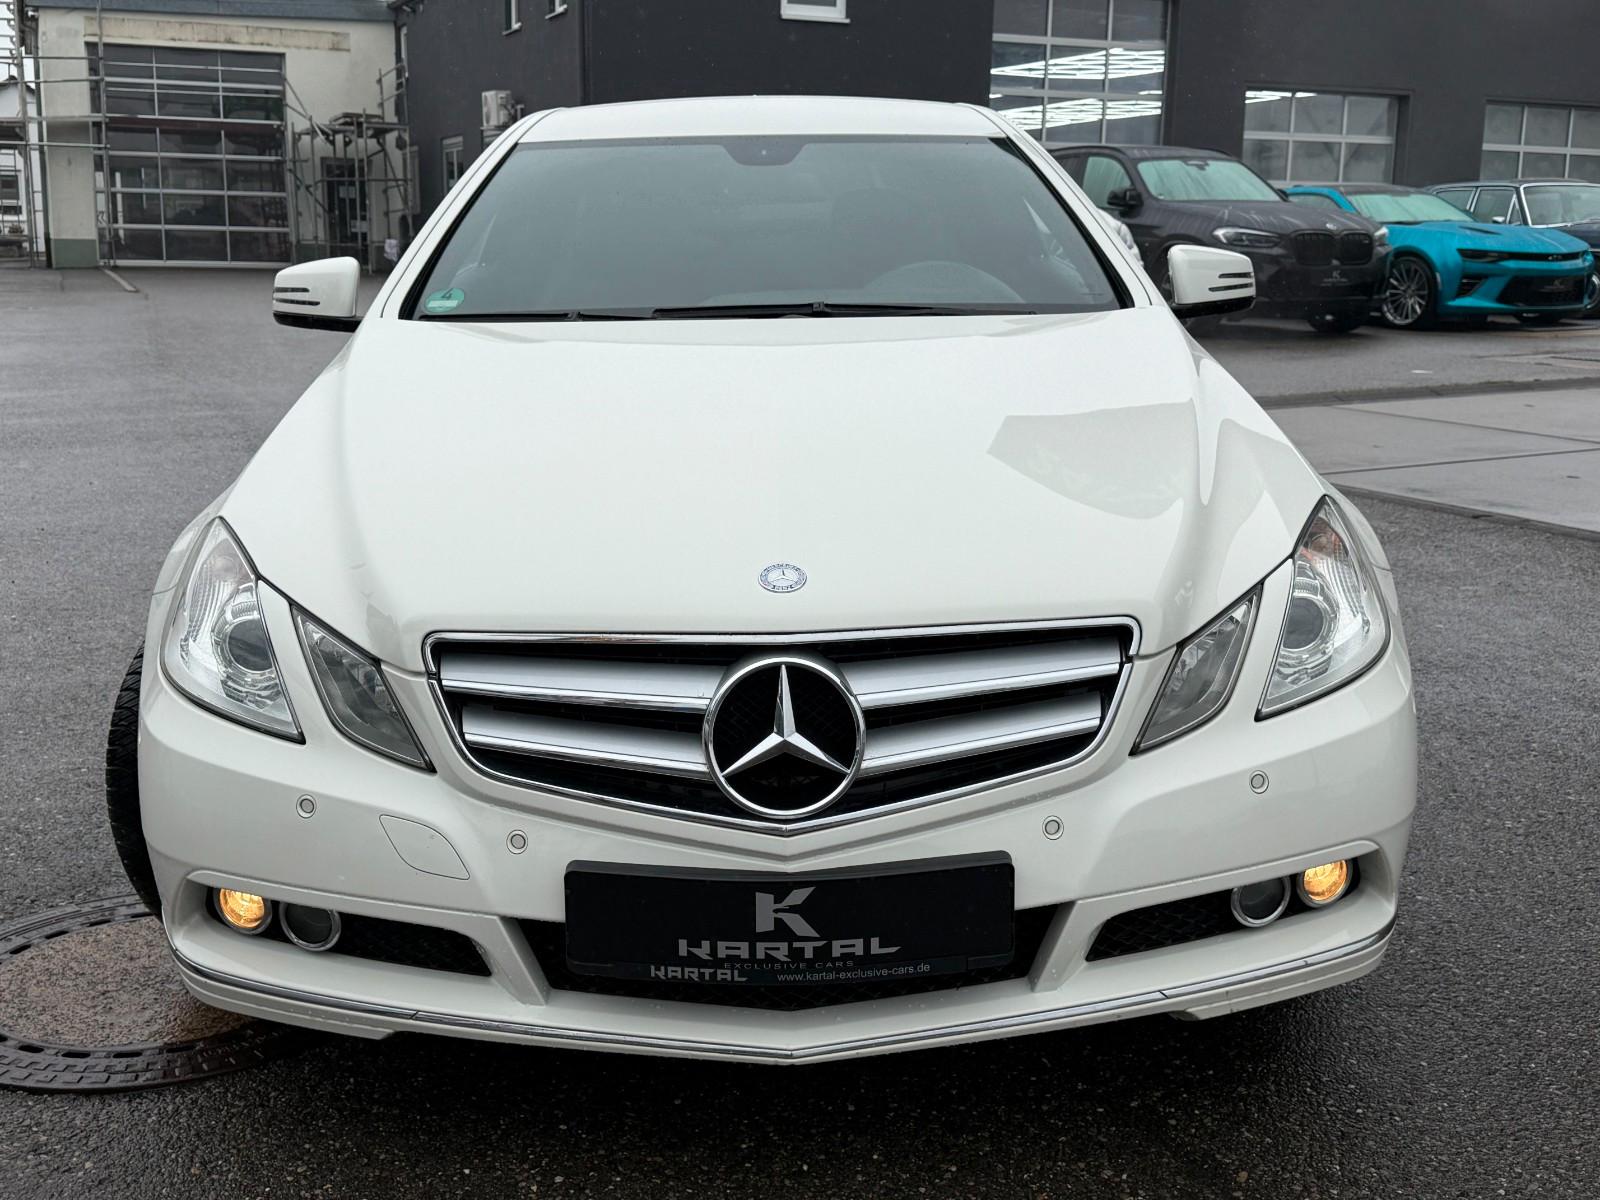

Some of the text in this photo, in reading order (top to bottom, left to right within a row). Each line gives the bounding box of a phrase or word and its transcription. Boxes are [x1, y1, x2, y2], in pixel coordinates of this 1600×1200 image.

[441, 288, 453, 301] 4
[755, 886, 821, 938] K
[678, 937, 902, 962] KARTAL
[650, 965, 748, 982] KARTAL
[724, 960, 854, 970] EXCLUSIVE CARS
[777, 962, 931, 982] www.kartal-exclusive-cars.de
